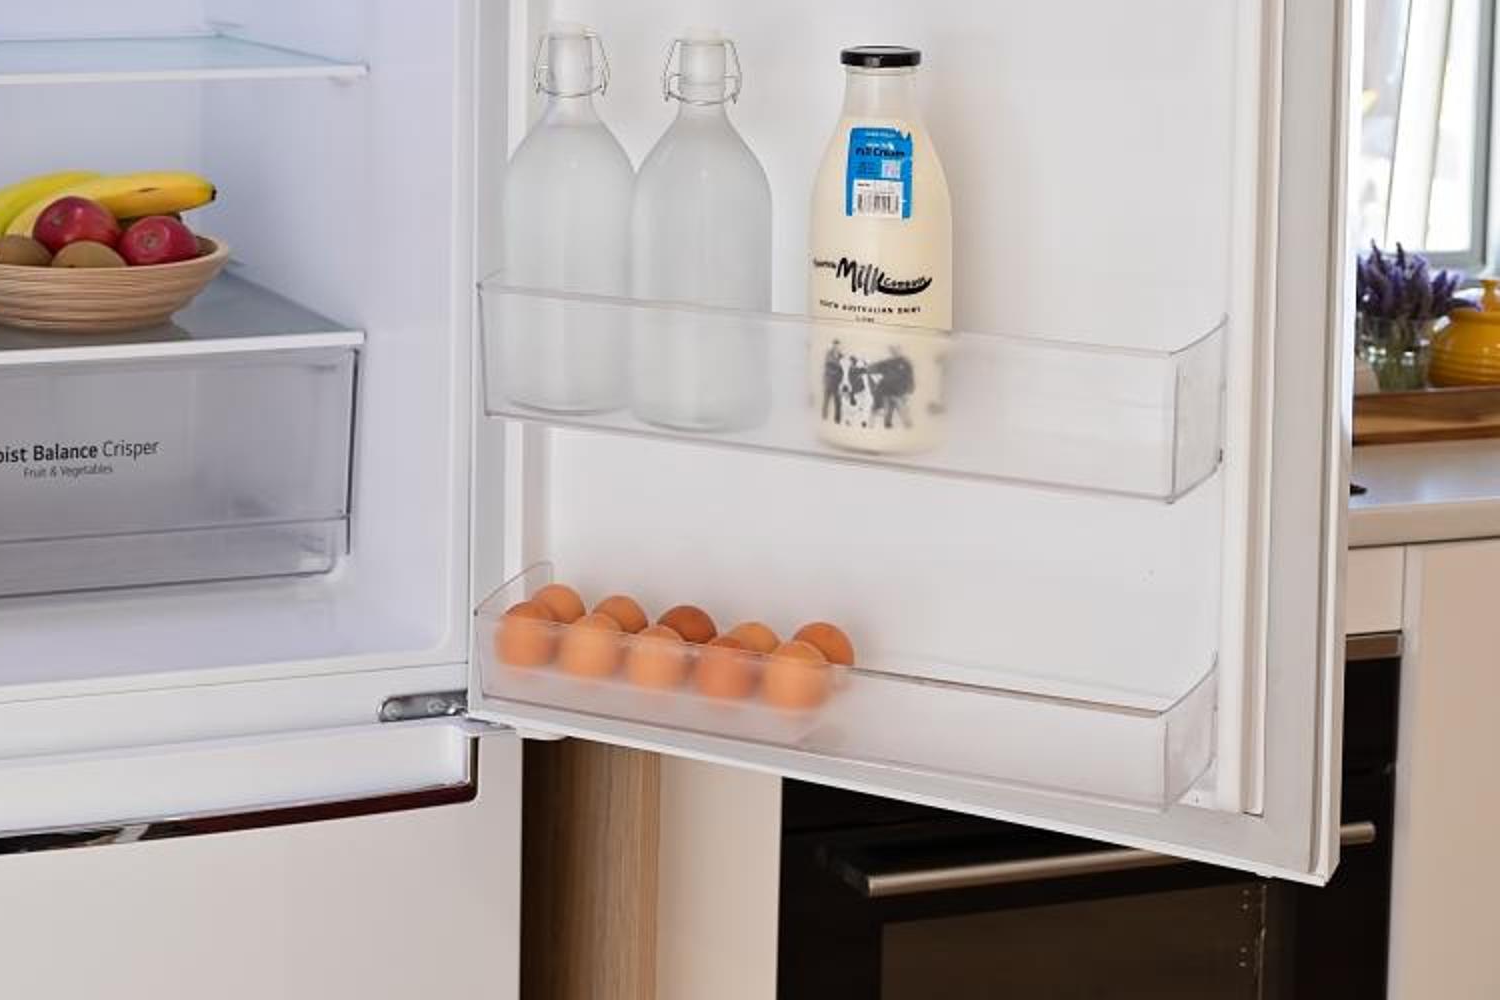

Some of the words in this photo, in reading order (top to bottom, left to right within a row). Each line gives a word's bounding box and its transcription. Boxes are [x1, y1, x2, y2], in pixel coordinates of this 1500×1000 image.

[836, 257, 885, 296] Milk
[32, 443, 98, 462] Balance
[102, 440, 160, 461] Crisper
[23, 466, 47, 478] Fruit
[60, 463, 114, 478] Vegetables
